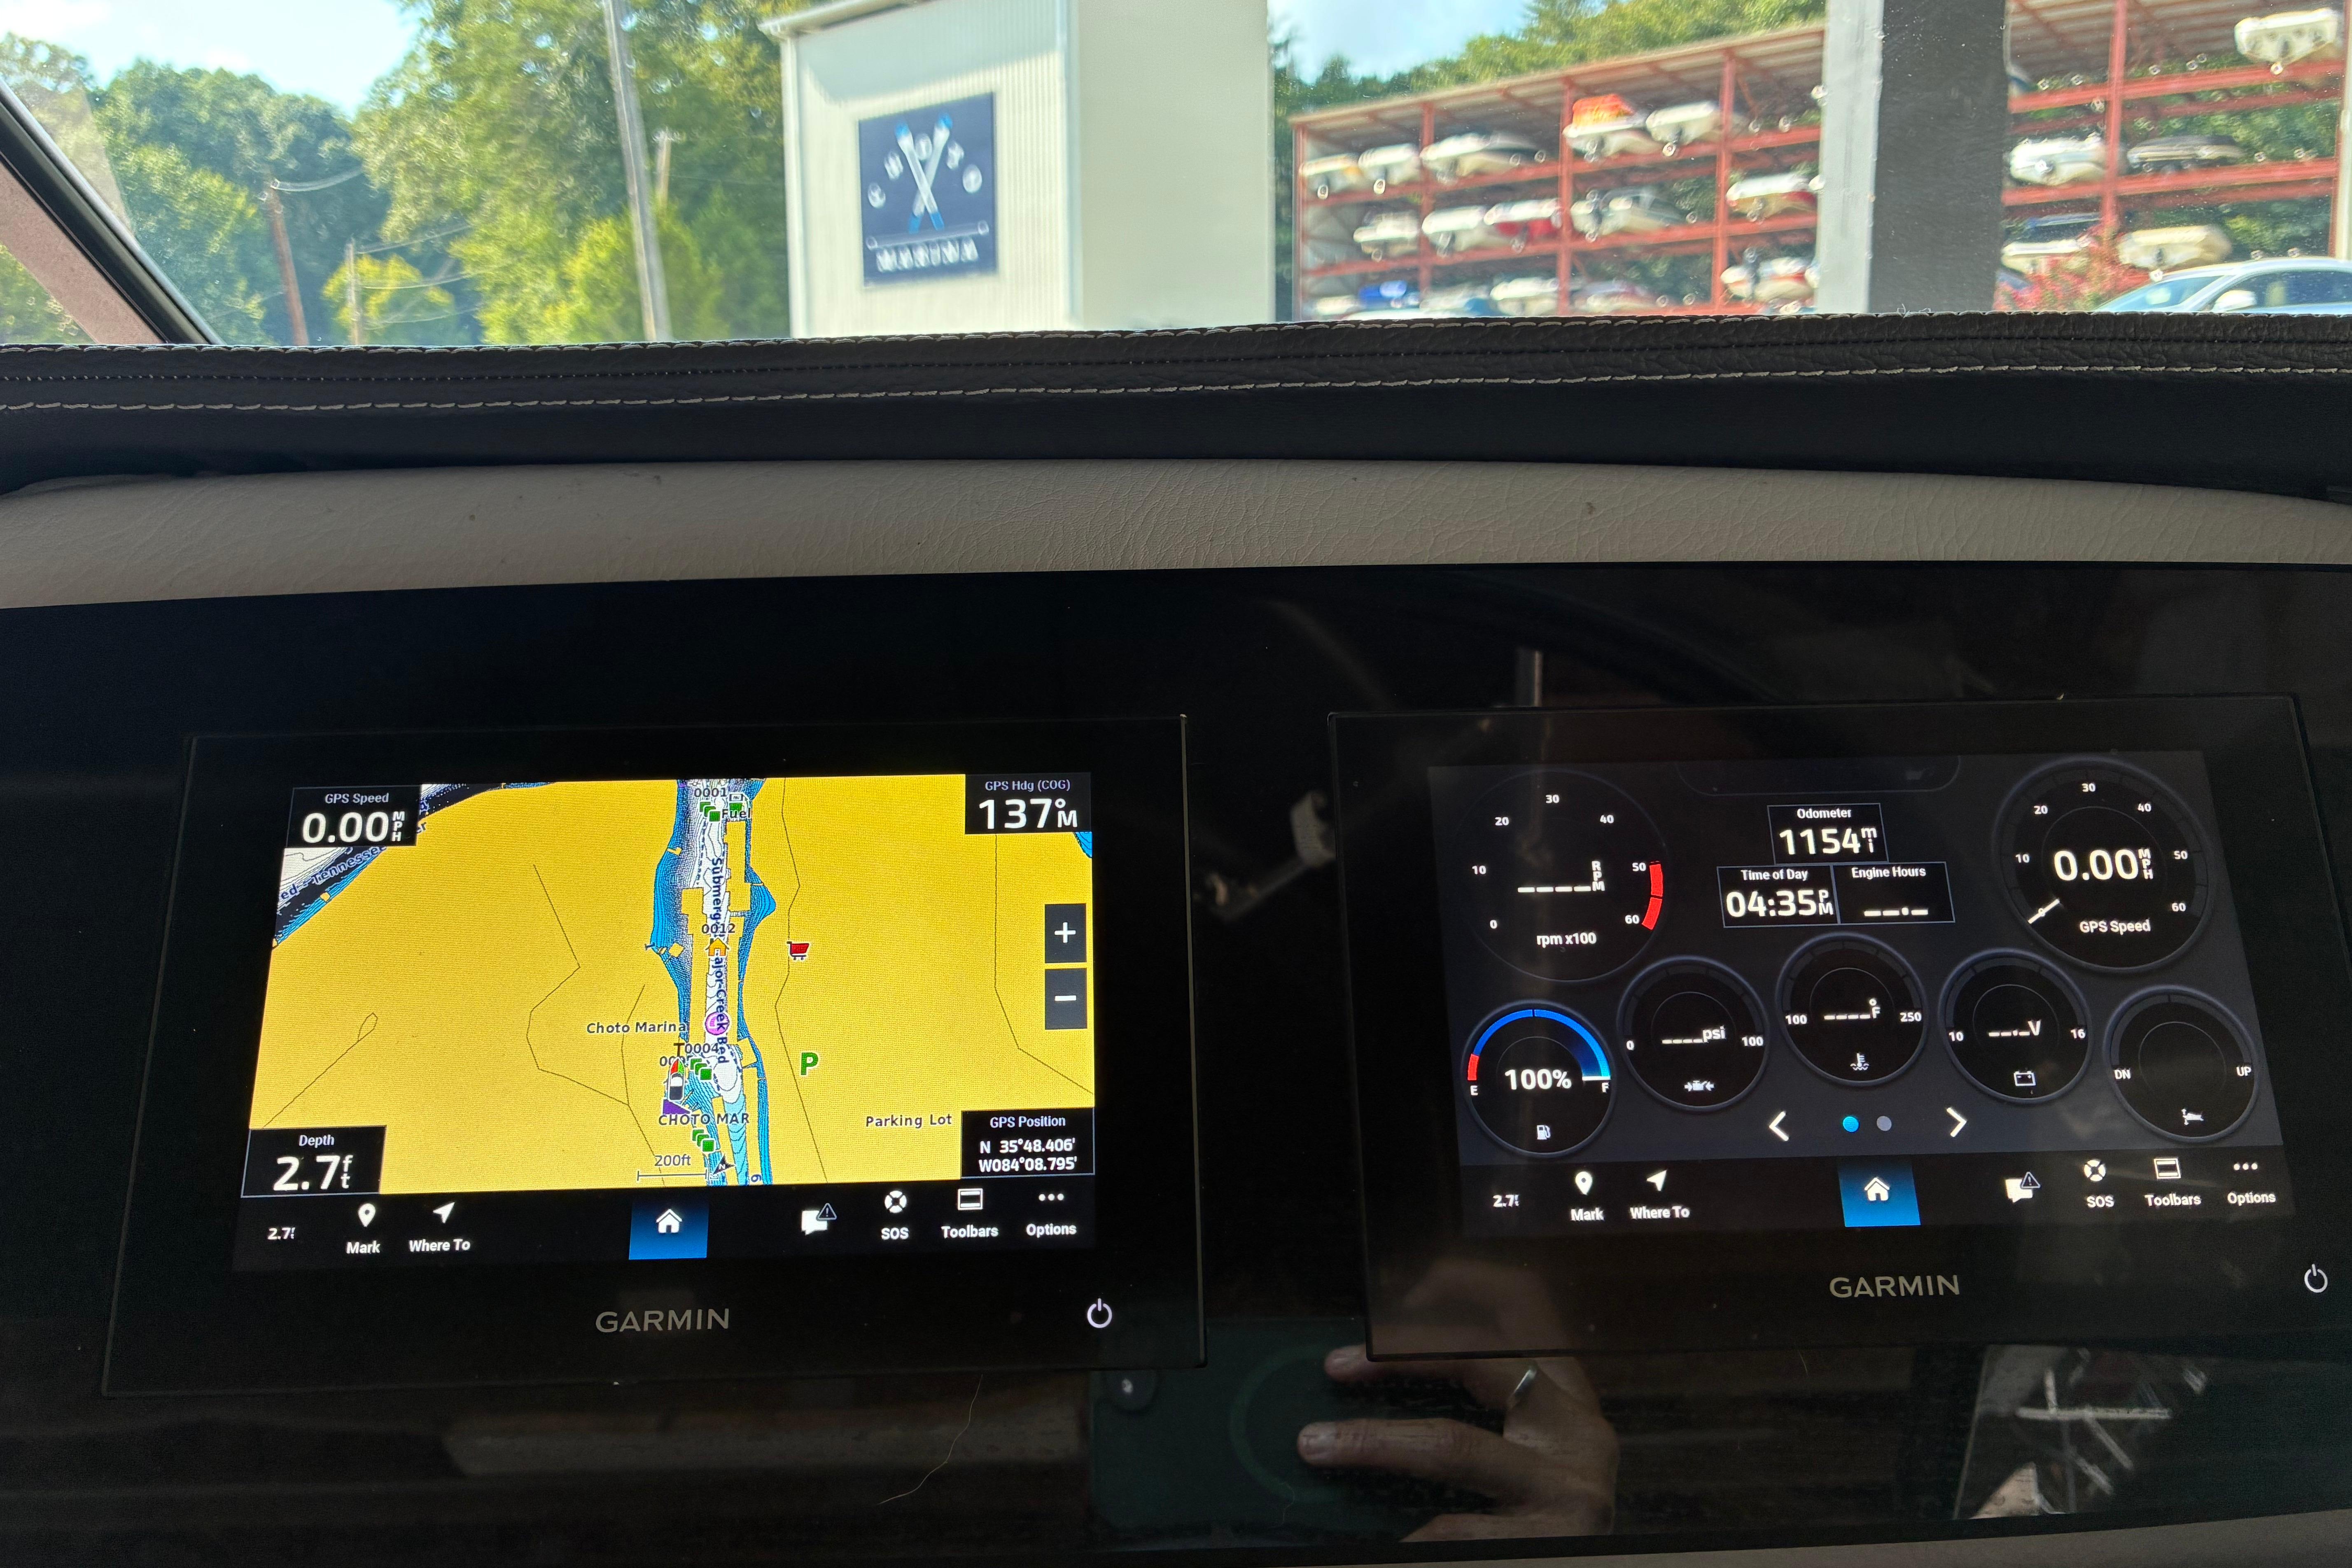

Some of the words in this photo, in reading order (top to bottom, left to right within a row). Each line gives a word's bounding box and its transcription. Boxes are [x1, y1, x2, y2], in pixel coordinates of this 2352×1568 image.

[694, 787, 727, 797] 0001
[985, 781, 1009, 791] GPS
[1012, 780, 1034, 792] Hdg
[1037, 779, 1070, 792] (COG)
[2081, 783, 2096, 792] 30
[325, 793, 350, 804] GPS
[352, 792, 389, 805] Speed
[1545, 794, 1560, 803] 30
[722, 807, 751, 818] Fuel
[1797, 808, 1852, 819] Odometer
[2034, 805, 2048, 814] 20
[2137, 803, 2151, 812] 40
[1495, 817, 1509, 826] 20
[1600, 814, 1614, 824] 40
[302, 812, 389, 843] 0.00
[1779, 828, 1861, 855] 1154
[2015, 854, 2030, 863] 10
[2174, 850, 2188, 860] 50
[1472, 865, 1486, 875] 10
[1632, 862, 1646, 872] 50
[2054, 849, 2139, 881] 0.00
[1741, 870, 1770, 880] Time
[1772, 868, 1784, 880] of
[1786, 868, 1808, 881] Day
[1851, 867, 1890, 880] Engine
[1892, 866, 1926, 877] Hours
[1726, 889, 1817, 917] 04:35
[2172, 902, 2186, 912] 60
[1490, 919, 1498, 929] 0
[1625, 915, 1640, 924] 60
[701, 923, 735, 933] 0012
[2079, 920, 2108, 933] GPS
[2109, 919, 2151, 936] Speed
[1536, 935, 1563, 948] rpm
[1565, 932, 1597, 945] x100
[1785, 1014, 1807, 1024] 100
[1899, 1012, 1922, 1022] 250
[586, 1022, 630, 1034] Choto
[635, 1021, 687, 1033] Marina
[2070, 1029, 2086, 1039] 16
[1741, 1036, 1764, 1046] 100
[1948, 1031, 1964, 1041] 10
[717, 1037, 730, 1064] Bed
[1626, 1040, 1635, 1050] 0
[2114, 1068, 2131, 1080] DN
[2236, 1066, 2252, 1076] UP
[1505, 1069, 1572, 1090] 100%
[1470, 1085, 1478, 1096] E
[1601, 1082, 1609, 1093] F
[658, 1113, 711, 1126] CHOTO
[716, 1112, 750, 1125] MAR
[866, 1114, 923, 1129] Parking
[930, 1113, 952, 1125] Lot
[990, 1116, 1015, 1128] GPS
[1018, 1115, 1066, 1127] Position
[299, 1134, 335, 1148] Depth
[654, 1153, 691, 1167] 200ft
[273, 1155, 341, 1191] 2.7
[2086, 1195, 2114, 1208] SOS
[2144, 1193, 2201, 1206] Toolbars
[2227, 1191, 2276, 1206] Options
[1570, 1207, 1604, 1221] Mark
[1630, 1206, 1671, 1219] Where
[1671, 1206, 1690, 1218] To
[881, 1227, 909, 1240] SOS
[941, 1224, 999, 1239] Toolbars
[1026, 1223, 1077, 1238] Options
[346, 1240, 380, 1254] Mark
[409, 1239, 450, 1252] Where
[453, 1238, 471, 1251] To
[1829, 1274, 1960, 1298] GARMIN
[595, 1308, 729, 1333] GARMIN
